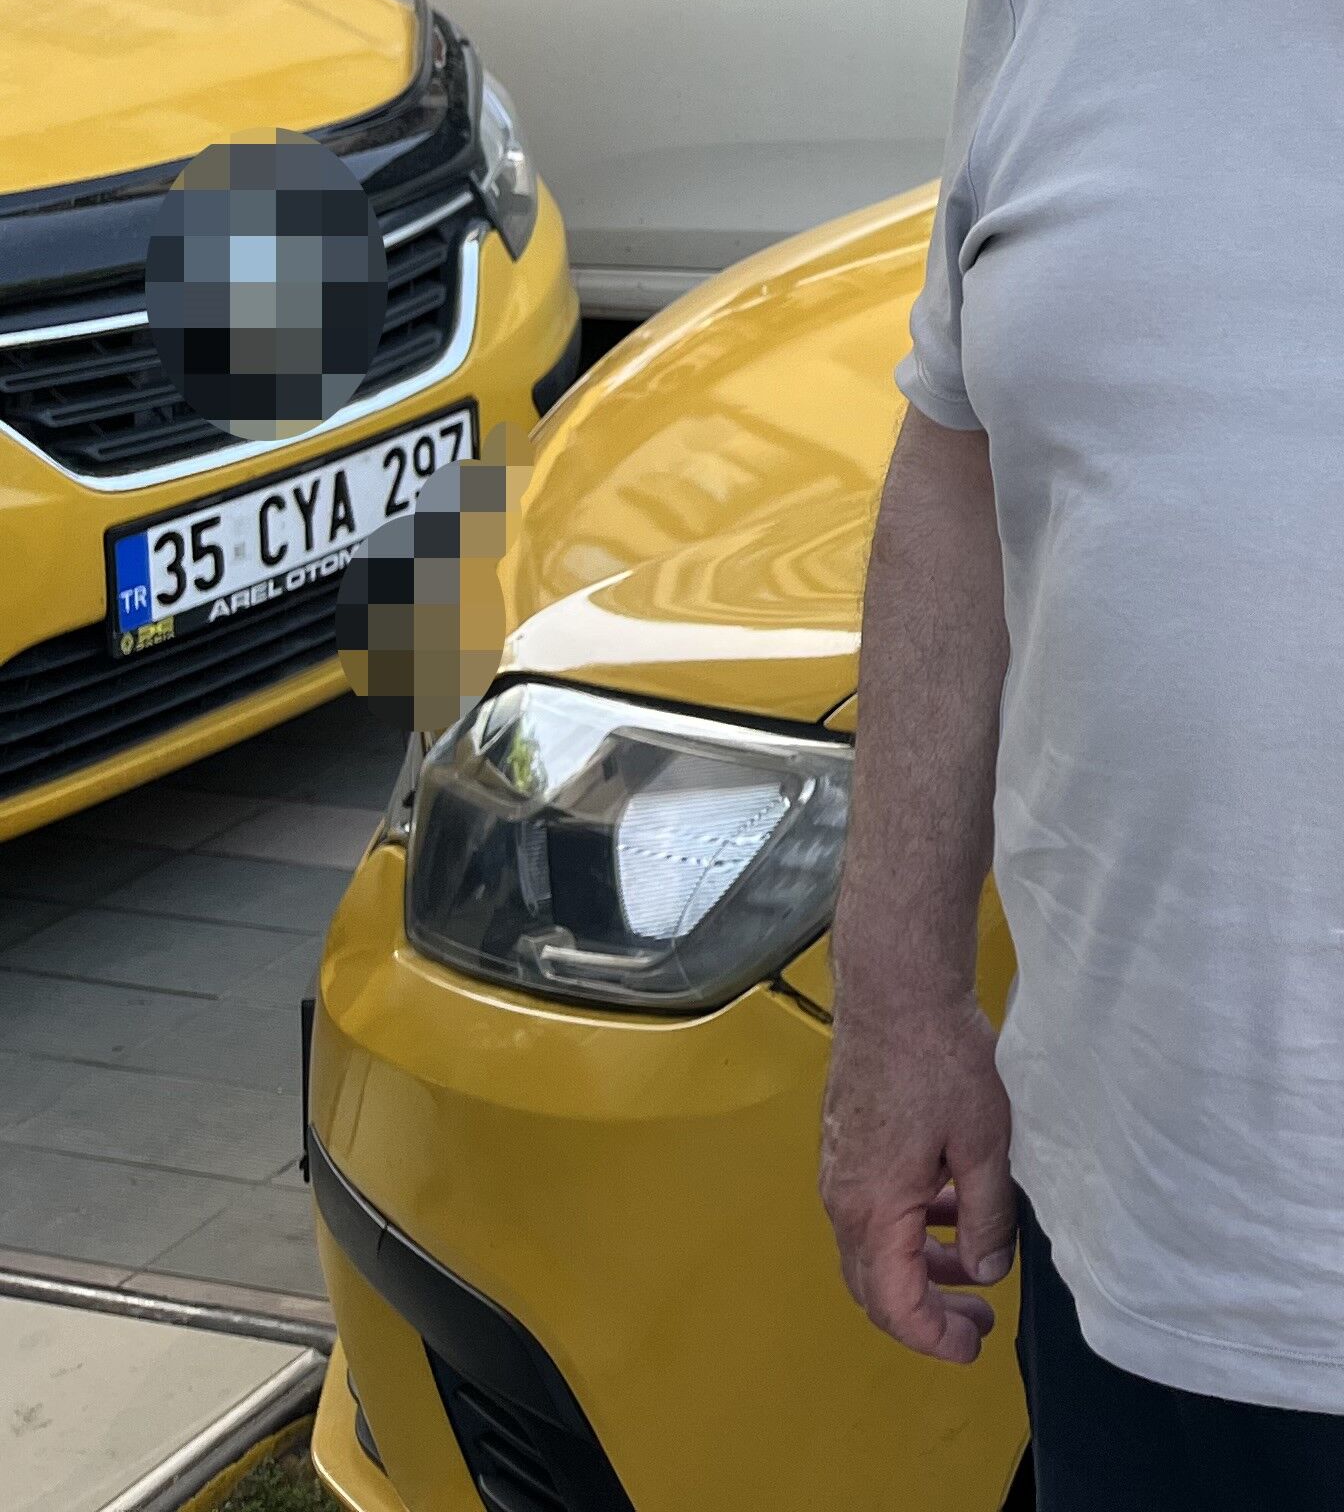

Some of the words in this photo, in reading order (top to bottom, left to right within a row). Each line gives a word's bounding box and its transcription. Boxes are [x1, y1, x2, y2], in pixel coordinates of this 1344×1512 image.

[153, 516, 225, 605] 35
[259, 470, 357, 567] CYA
[382, 421, 464, 517] 297
[120, 584, 148, 614] TR
[207, 574, 285, 623] AREL
[286, 542, 363, 590] OTOM
